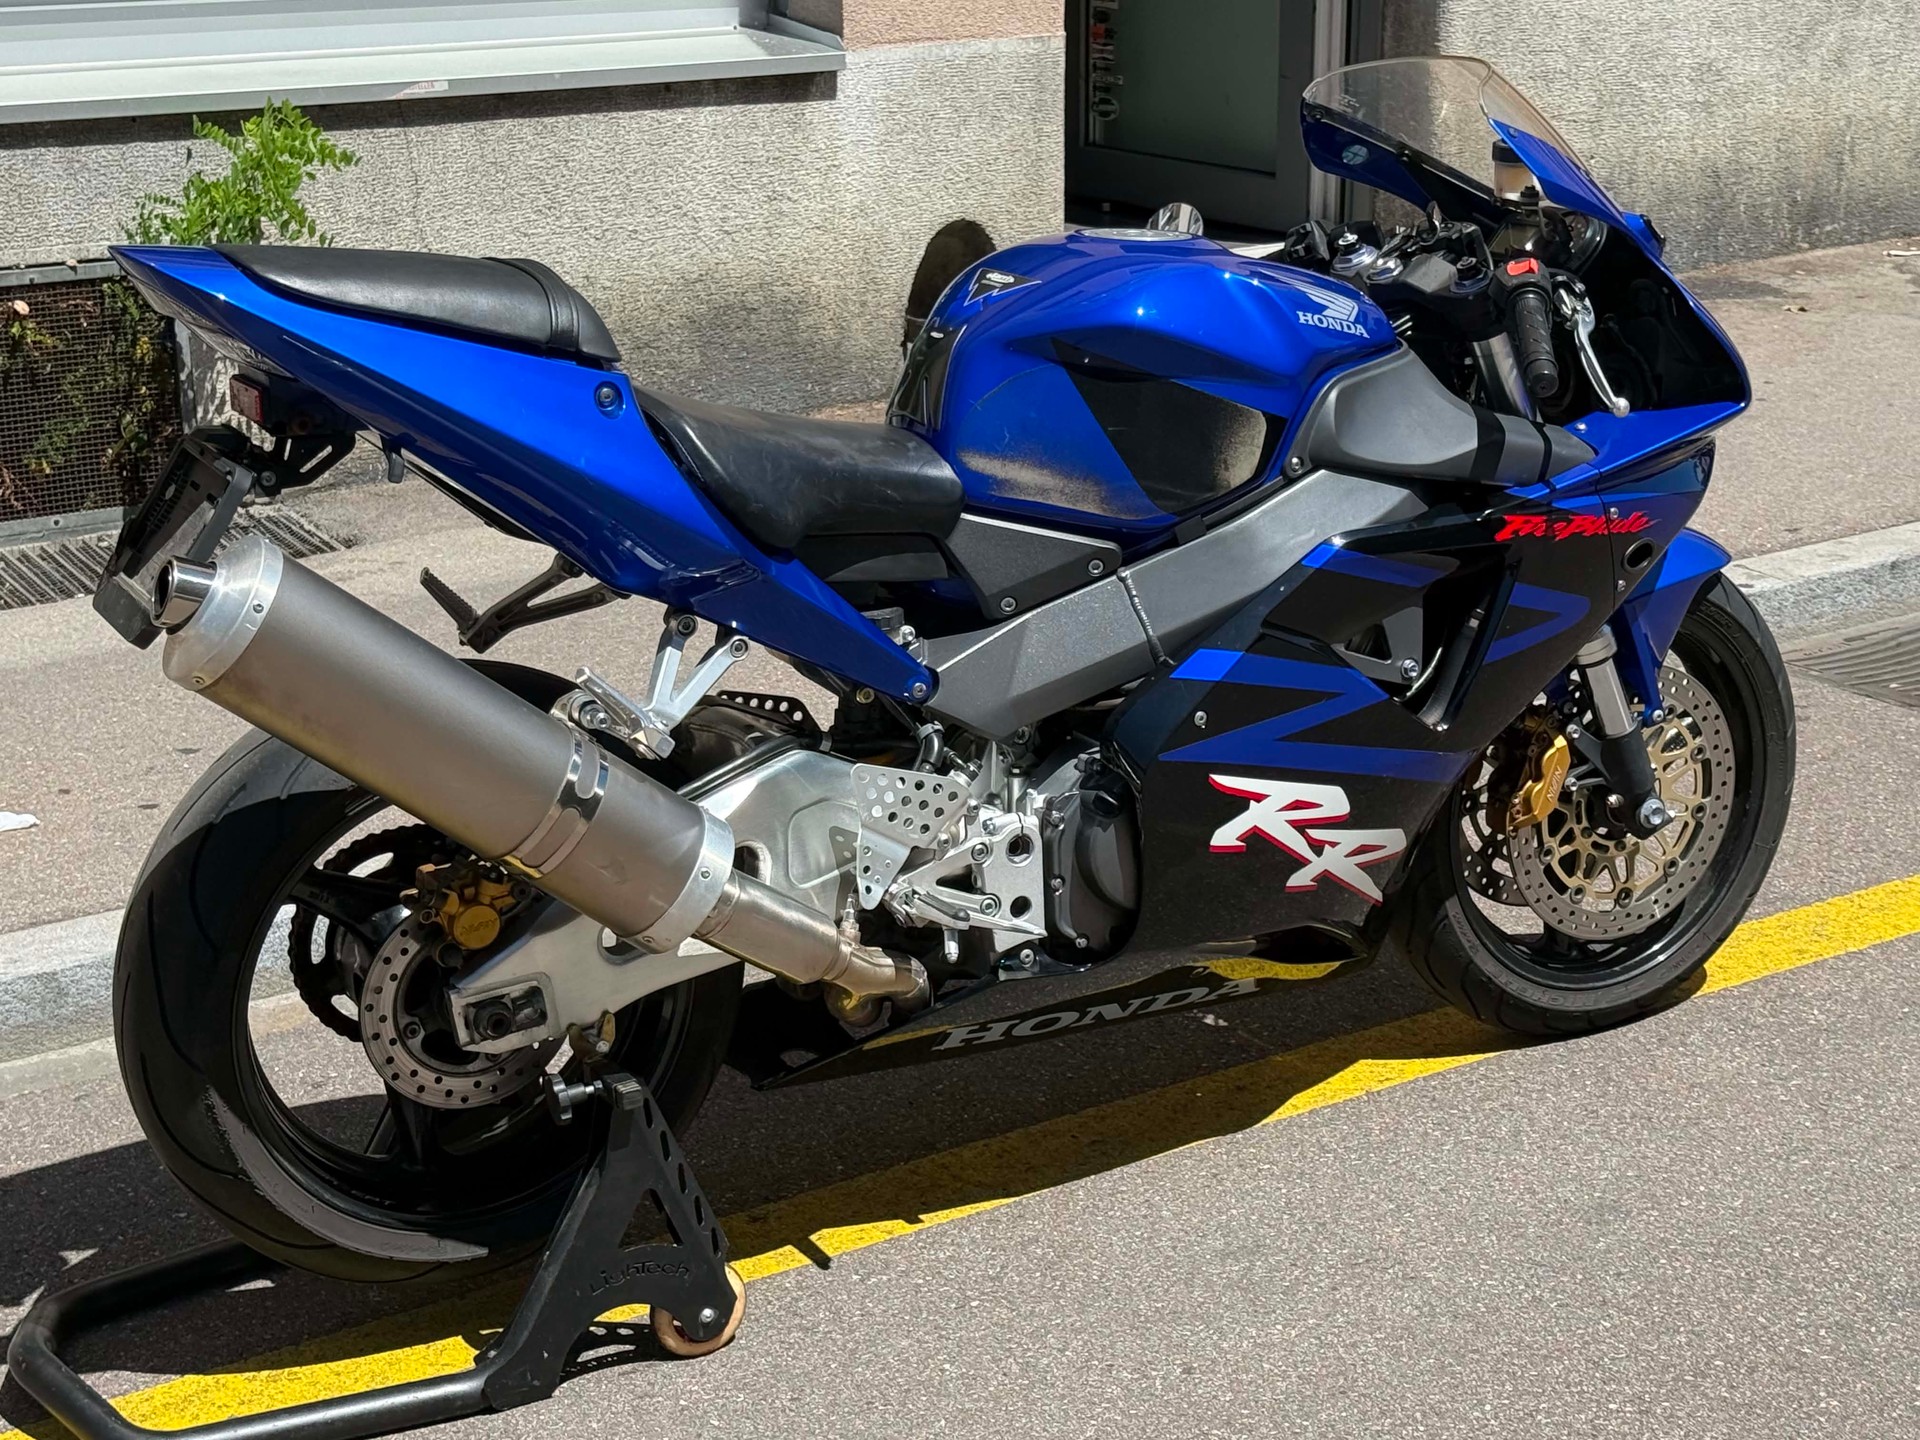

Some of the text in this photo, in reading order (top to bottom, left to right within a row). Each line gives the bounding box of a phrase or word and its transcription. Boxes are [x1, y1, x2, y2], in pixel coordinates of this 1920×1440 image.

[1296, 310, 1371, 339] HONDA
[1208, 774, 1407, 907] RR
[932, 978, 1261, 1051] HONDA
